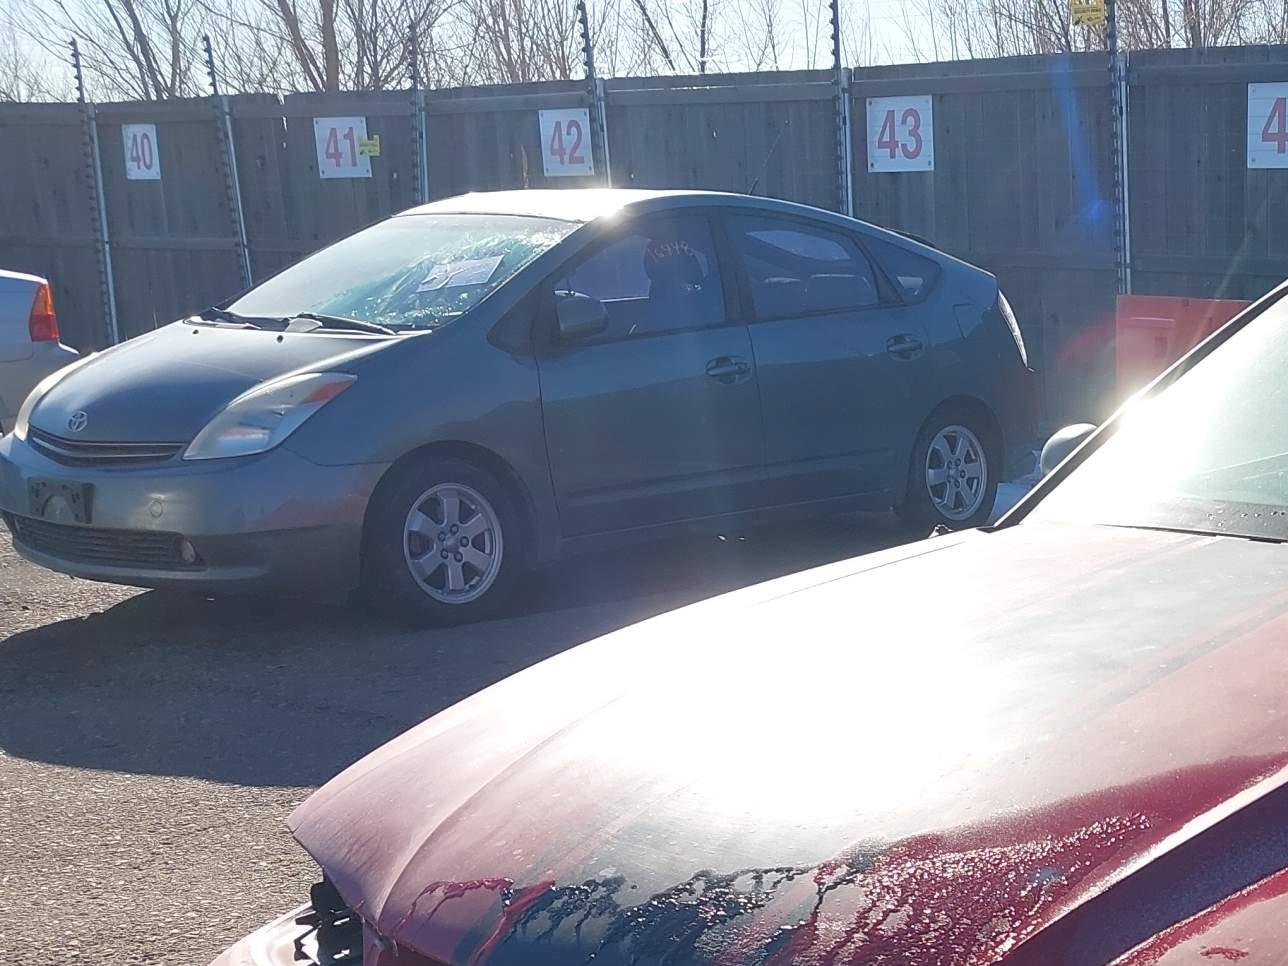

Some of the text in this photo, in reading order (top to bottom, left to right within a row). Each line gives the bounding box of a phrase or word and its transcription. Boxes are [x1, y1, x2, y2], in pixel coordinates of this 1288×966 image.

[130, 133, 153, 170] 40
[324, 127, 358, 167] 41
[550, 119, 584, 164] 42
[876, 109, 922, 159] 43
